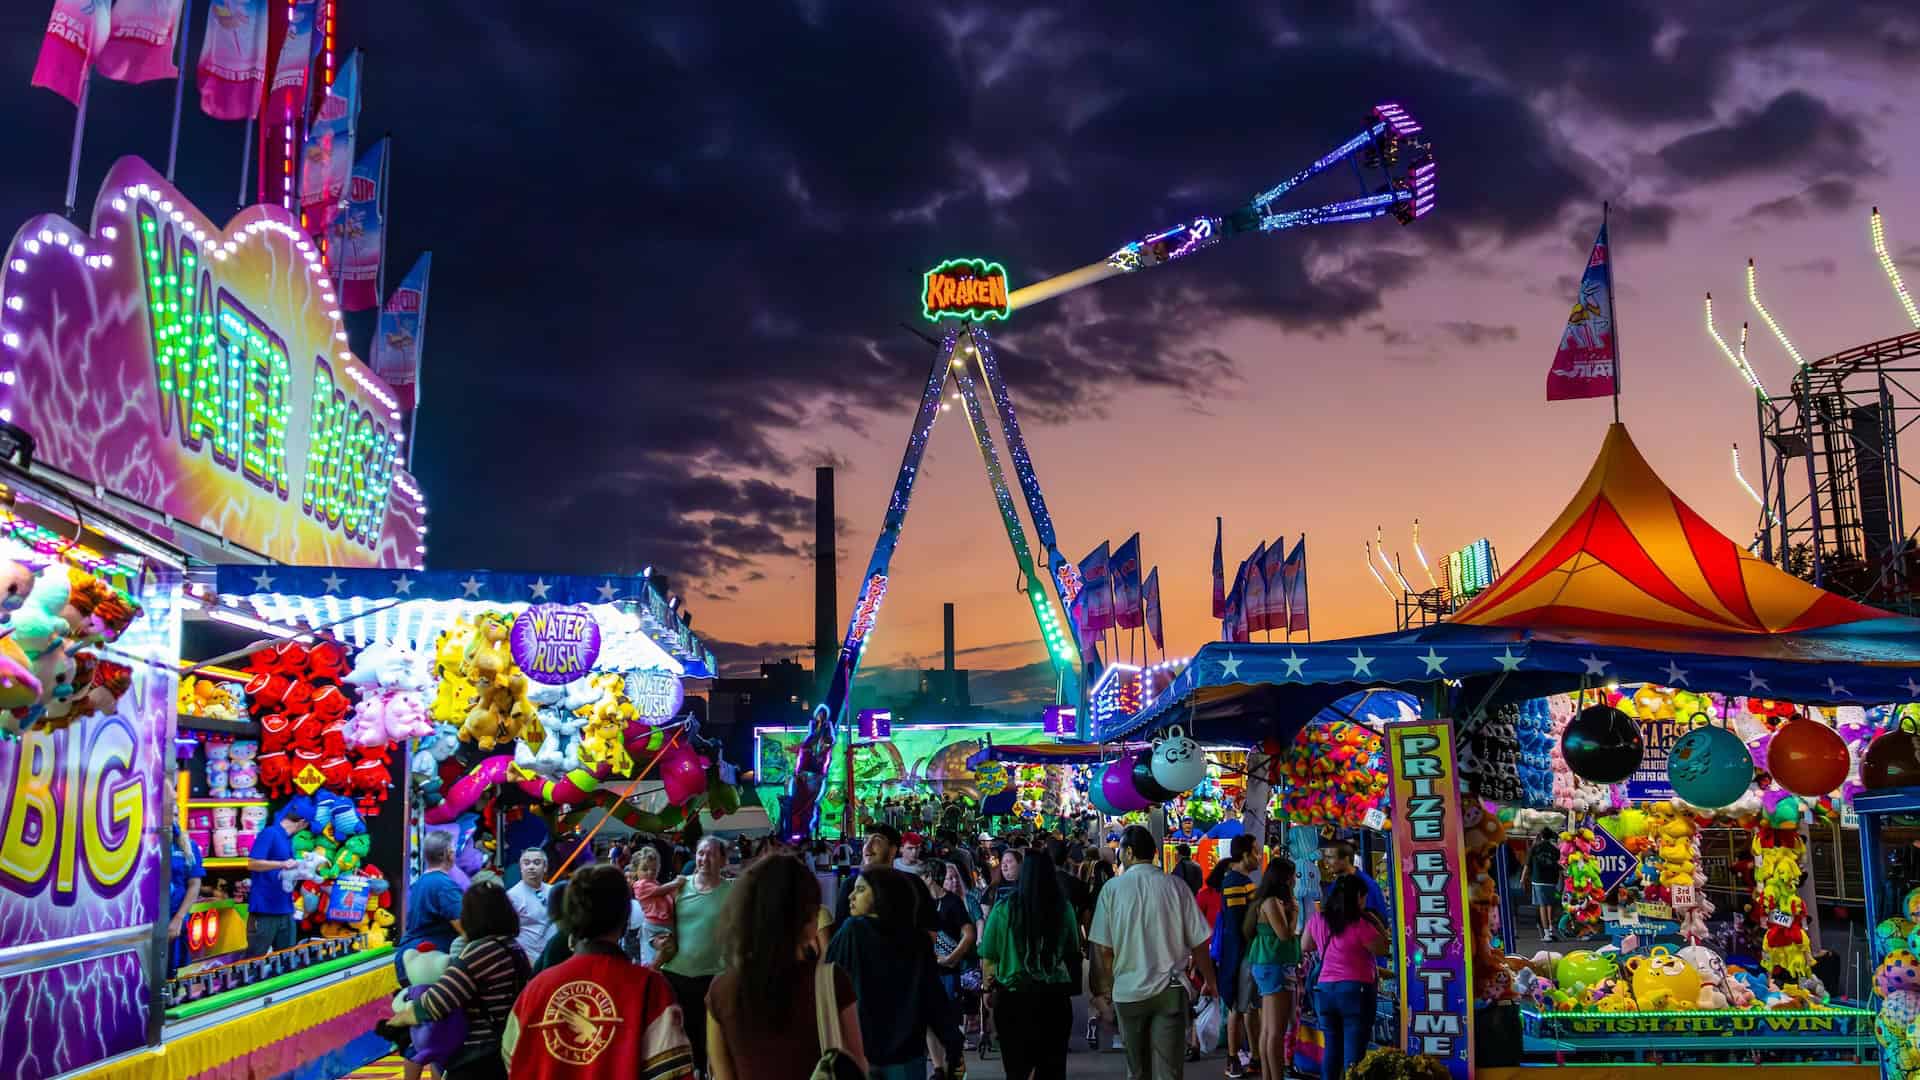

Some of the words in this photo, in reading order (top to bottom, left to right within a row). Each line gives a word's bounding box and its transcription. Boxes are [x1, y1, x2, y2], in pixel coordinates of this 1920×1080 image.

[927, 273, 1007, 309] KRAKEN
[139, 203, 289, 498] WATER
[303, 356, 397, 549] RUSH
[533, 609, 587, 643] WATER
[533, 644, 581, 674] RUSH
[631, 673, 674, 697] WATER
[637, 695, 673, 718] RUSH
[1402, 734, 1445, 842] PRIZE
[0, 718, 144, 893] BIG
[1411, 852, 1456, 958] EVERY
[1675, 895, 1692, 904] WIN
[594, 991, 613, 1016] CUP
[1414, 970, 1461, 1057] TIME
[1590, 1016, 1658, 1033] FISH
[1732, 1016, 1755, 1032] U
[1768, 1016, 1833, 1032] WIN
